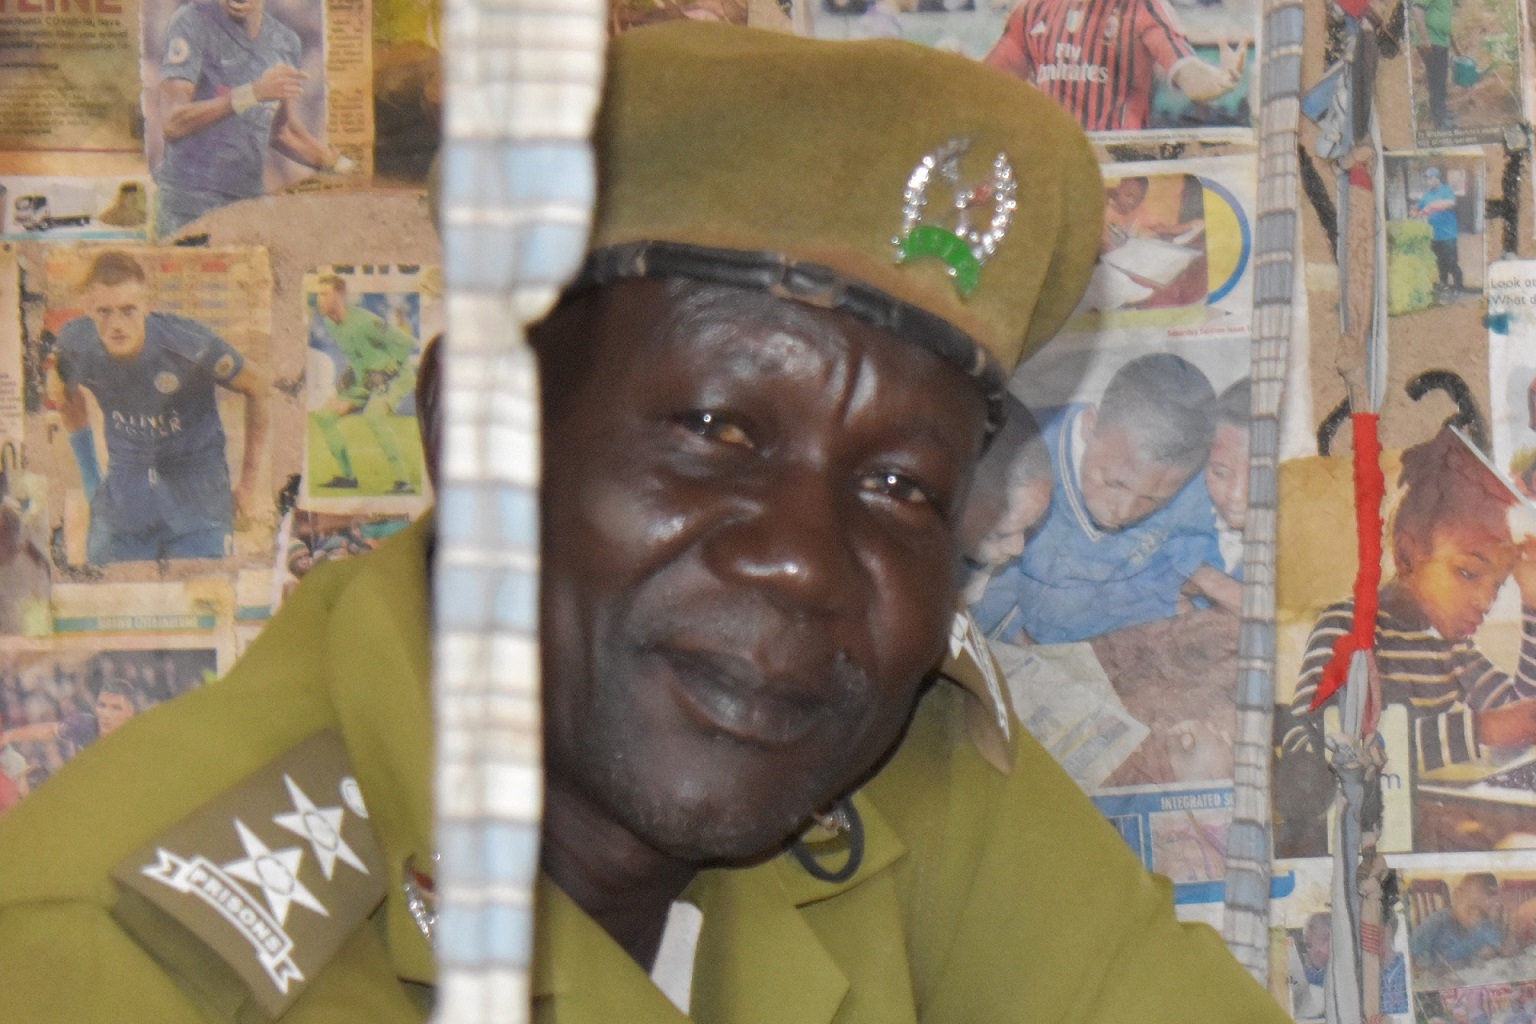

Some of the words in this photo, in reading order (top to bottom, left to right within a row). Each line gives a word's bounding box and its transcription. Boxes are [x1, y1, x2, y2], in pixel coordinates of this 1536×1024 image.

[1056, 43, 1081, 63] Fly
[1490, 277, 1521, 289] Look
[1525, 278, 1536, 288] at
[1491, 294, 1526, 305] What
[1161, 793, 1221, 810] INTEGRATED
[188, 866, 282, 953] PRISONS
